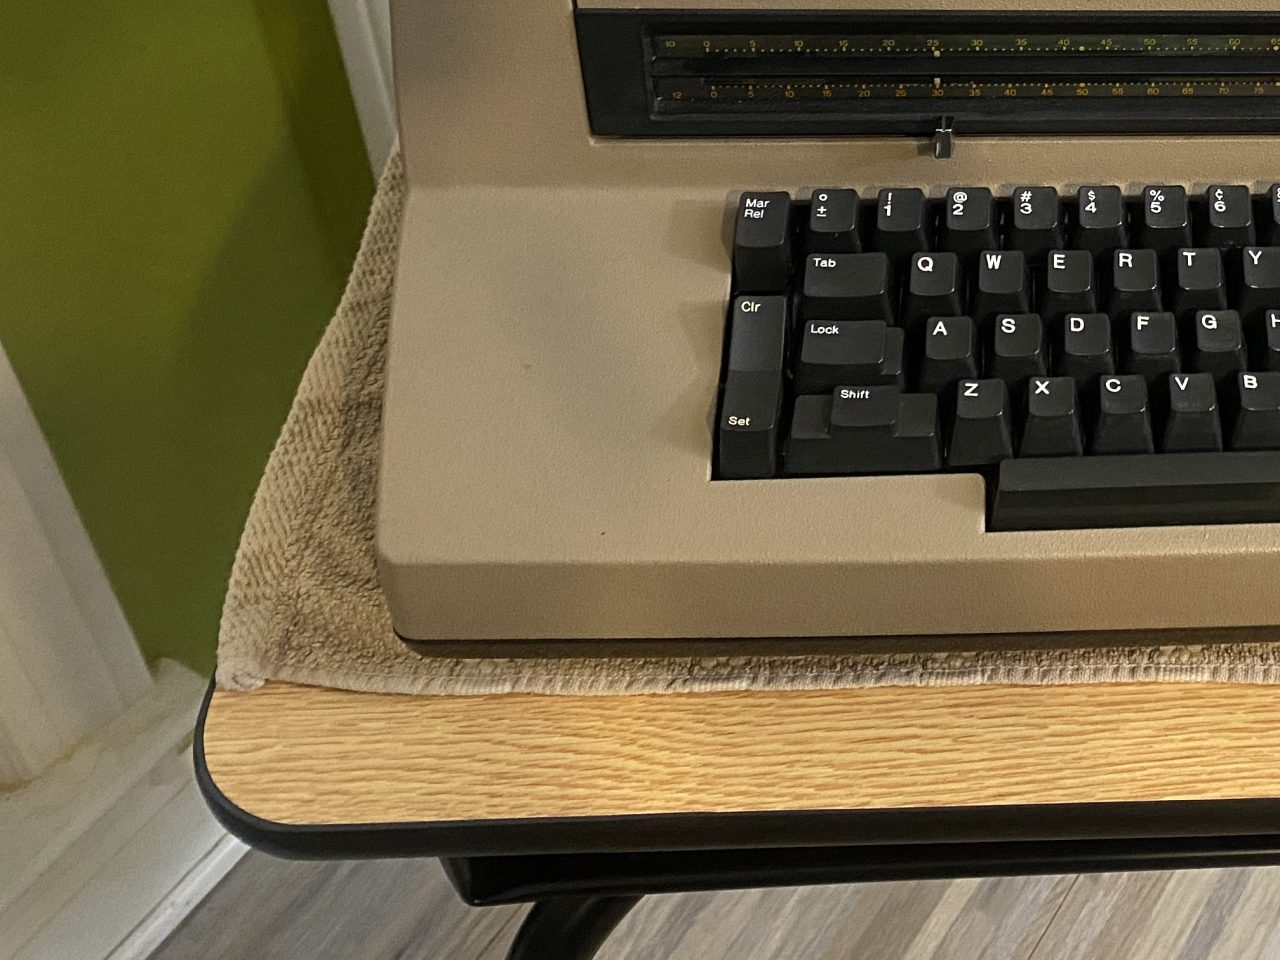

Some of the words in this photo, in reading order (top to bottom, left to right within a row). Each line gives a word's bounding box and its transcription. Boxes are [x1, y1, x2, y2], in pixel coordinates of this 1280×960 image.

[888, 193, 892, 204] !
[953, 192, 967, 203] @
[1021, 191, 1032, 202] #
[1088, 190, 1095, 201] $
[1150, 190, 1164, 201] %
[746, 199, 769, 208] Mar
[1020, 203, 1032, 214] 3
[1085, 203, 1096, 213] 4
[1151, 202, 1161, 213] 5
[1215, 202, 1226, 212] 6
[745, 209, 763, 218] Rel
[884, 206, 891, 216] 1
[953, 205, 963, 215] 2
[814, 258, 836, 267] Tab
[986, 254, 1001, 269] W
[1054, 254, 1065, 269] E
[1119, 253, 1132, 267] R
[1183, 252, 1196, 266] T
[1249, 250, 1262, 264] Y
[918, 257, 933, 271] Q
[741, 301, 760, 312] Clr
[1001, 319, 1015, 333] S
[1071, 318, 1084, 331] D
[1137, 316, 1149, 330] F
[1202, 315, 1217, 329] G
[811, 324, 838, 334] Lock
[933, 321, 947, 335] A
[1106, 379, 1121, 392] C
[1175, 377, 1188, 390] V
[1244, 375, 1257, 388] B
[964, 383, 978, 396] Z
[1035, 381, 1049, 394] X
[841, 390, 869, 398] Shift
[729, 416, 750, 425] Set
